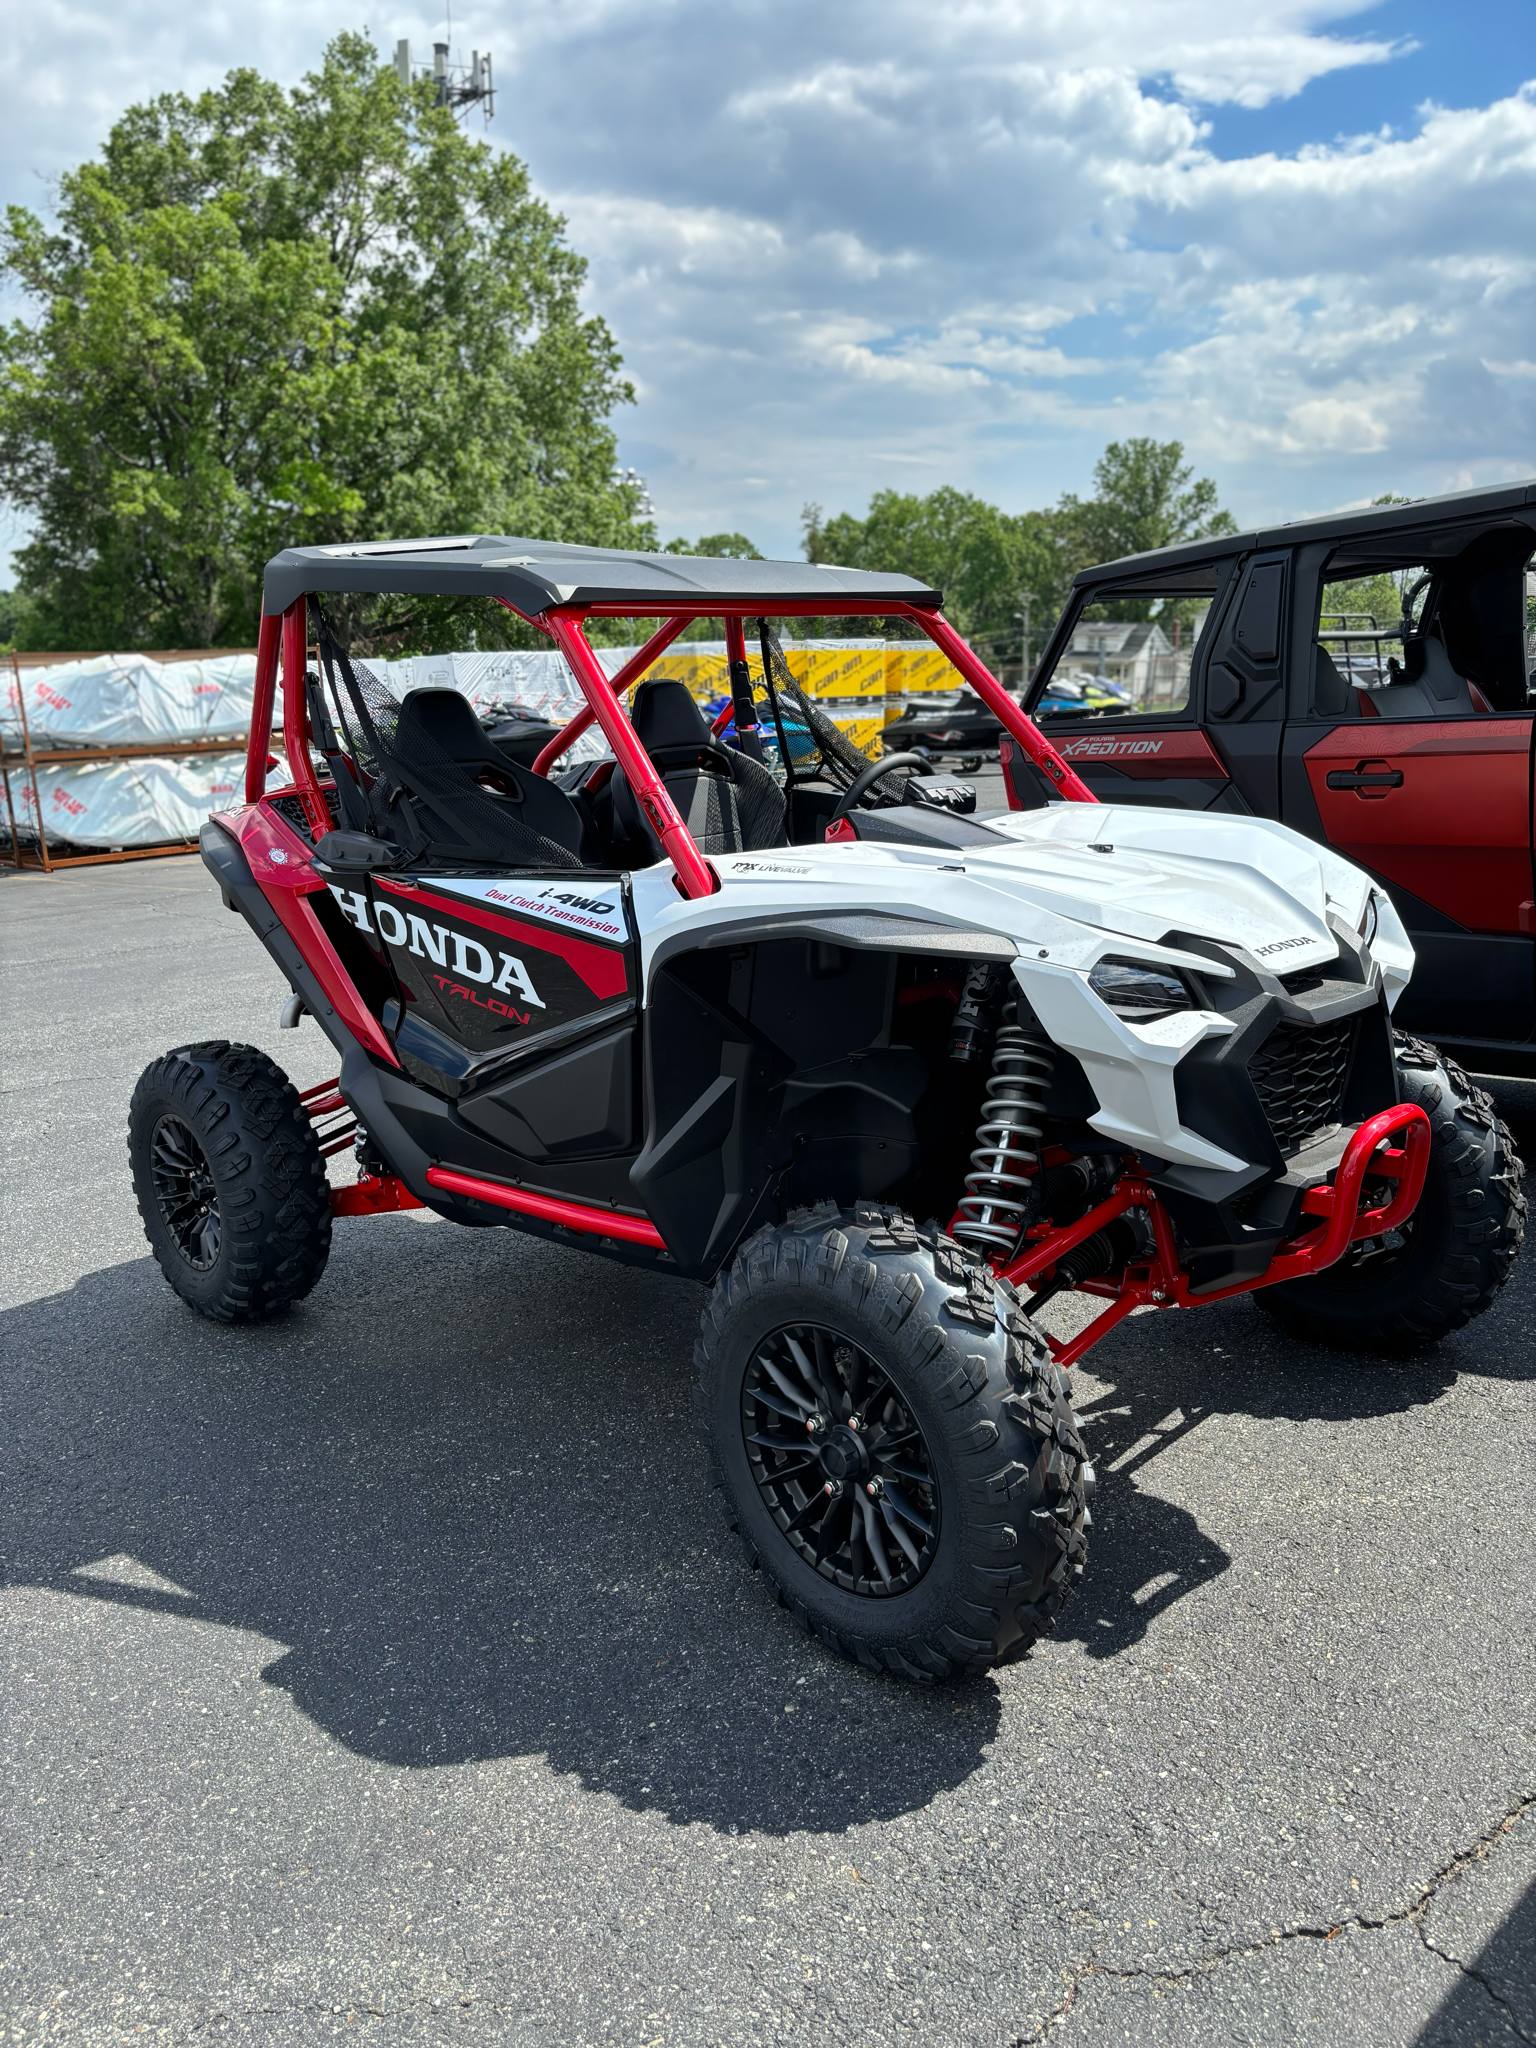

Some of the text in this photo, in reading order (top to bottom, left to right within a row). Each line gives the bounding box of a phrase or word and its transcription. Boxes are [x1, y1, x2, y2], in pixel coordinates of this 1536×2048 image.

[1060, 737, 1163, 756] XPEDITION
[485, 889, 620, 935] Dual Clutch Transmission
[537, 888, 616, 915] i-4WD
[326, 882, 546, 1009] HONDA
[1253, 936, 1318, 957] HONDA
[433, 974, 531, 1024] TALON
